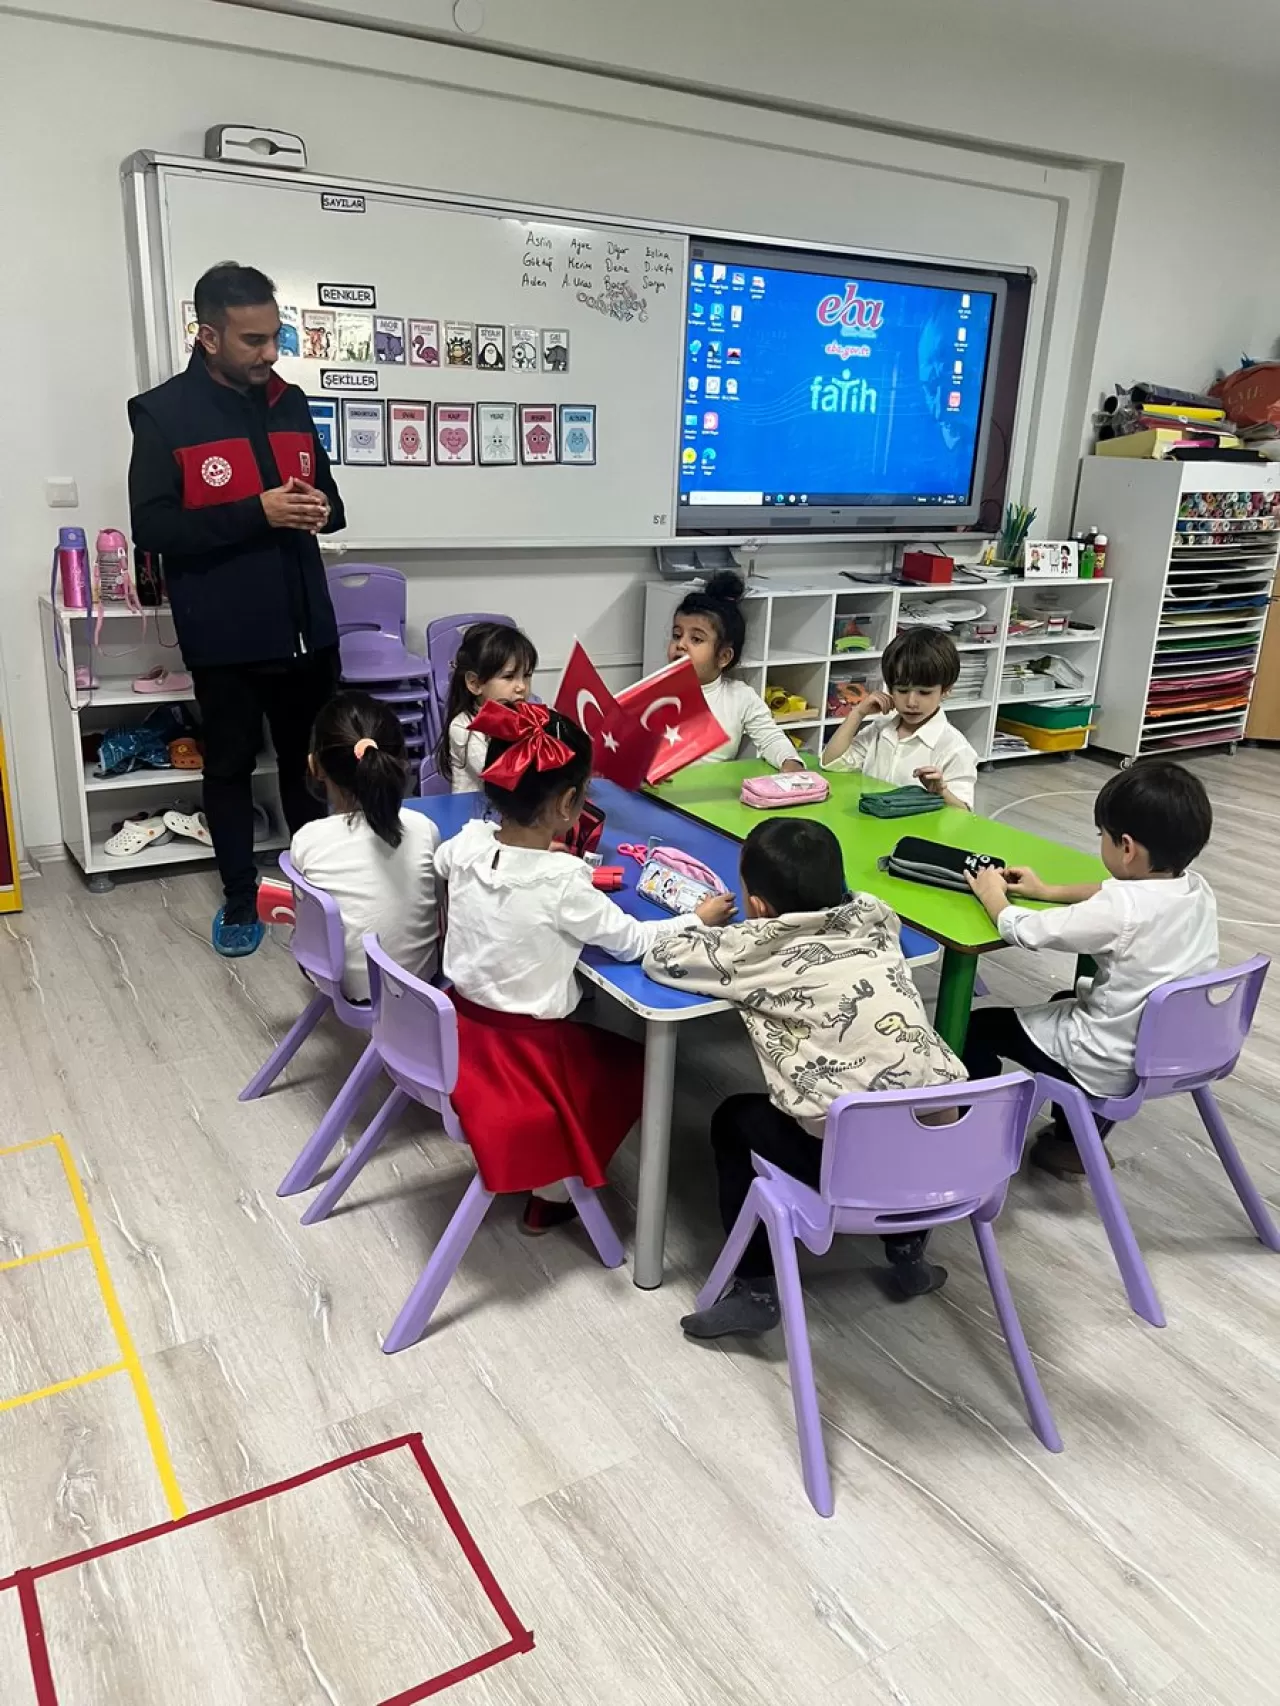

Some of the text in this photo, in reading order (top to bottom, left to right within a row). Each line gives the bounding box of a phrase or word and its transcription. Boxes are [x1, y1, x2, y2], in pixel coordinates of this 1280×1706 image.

[323, 198, 363, 208] SAYILAR
[323, 289, 371, 301] RENKLER
[817, 283, 883, 330] eba
[325, 373, 375, 386] ŞEKİLLER
[810, 368, 877, 413] fatih
